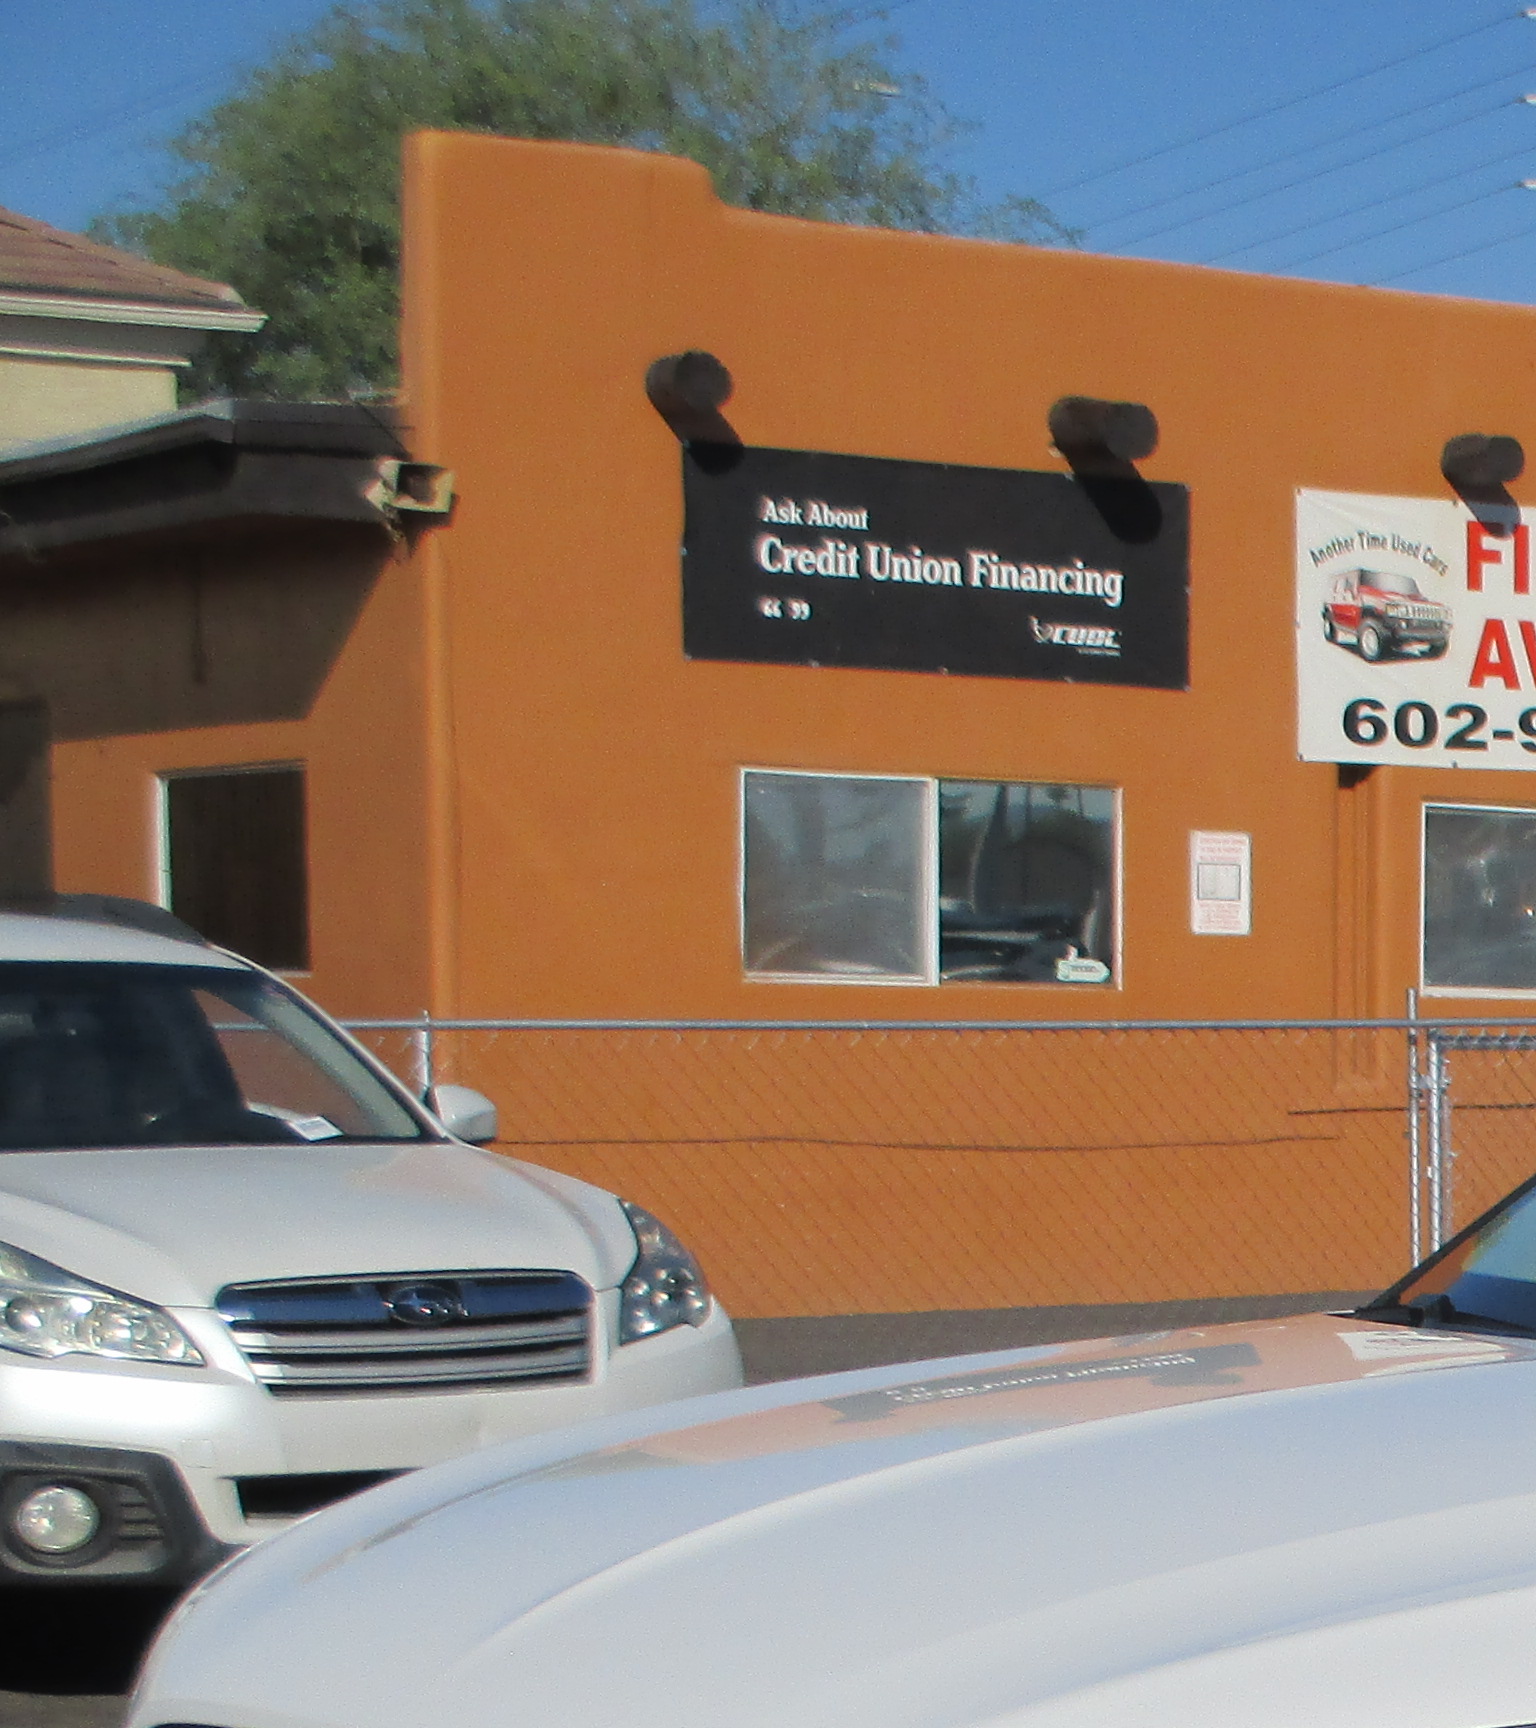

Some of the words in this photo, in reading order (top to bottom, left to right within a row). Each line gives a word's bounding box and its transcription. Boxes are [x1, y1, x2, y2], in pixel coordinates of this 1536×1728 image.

[761, 496, 803, 525] Ask
[806, 499, 869, 531] About
[756, 534, 860, 579] Credit
[865, 541, 964, 588] Union
[967, 550, 1124, 608] Financing
[1309, 535, 1355, 568] Another
[1357, 528, 1388, 551] Time
[1391, 532, 1422, 561] Used
[1422, 546, 1449, 577] Cars
